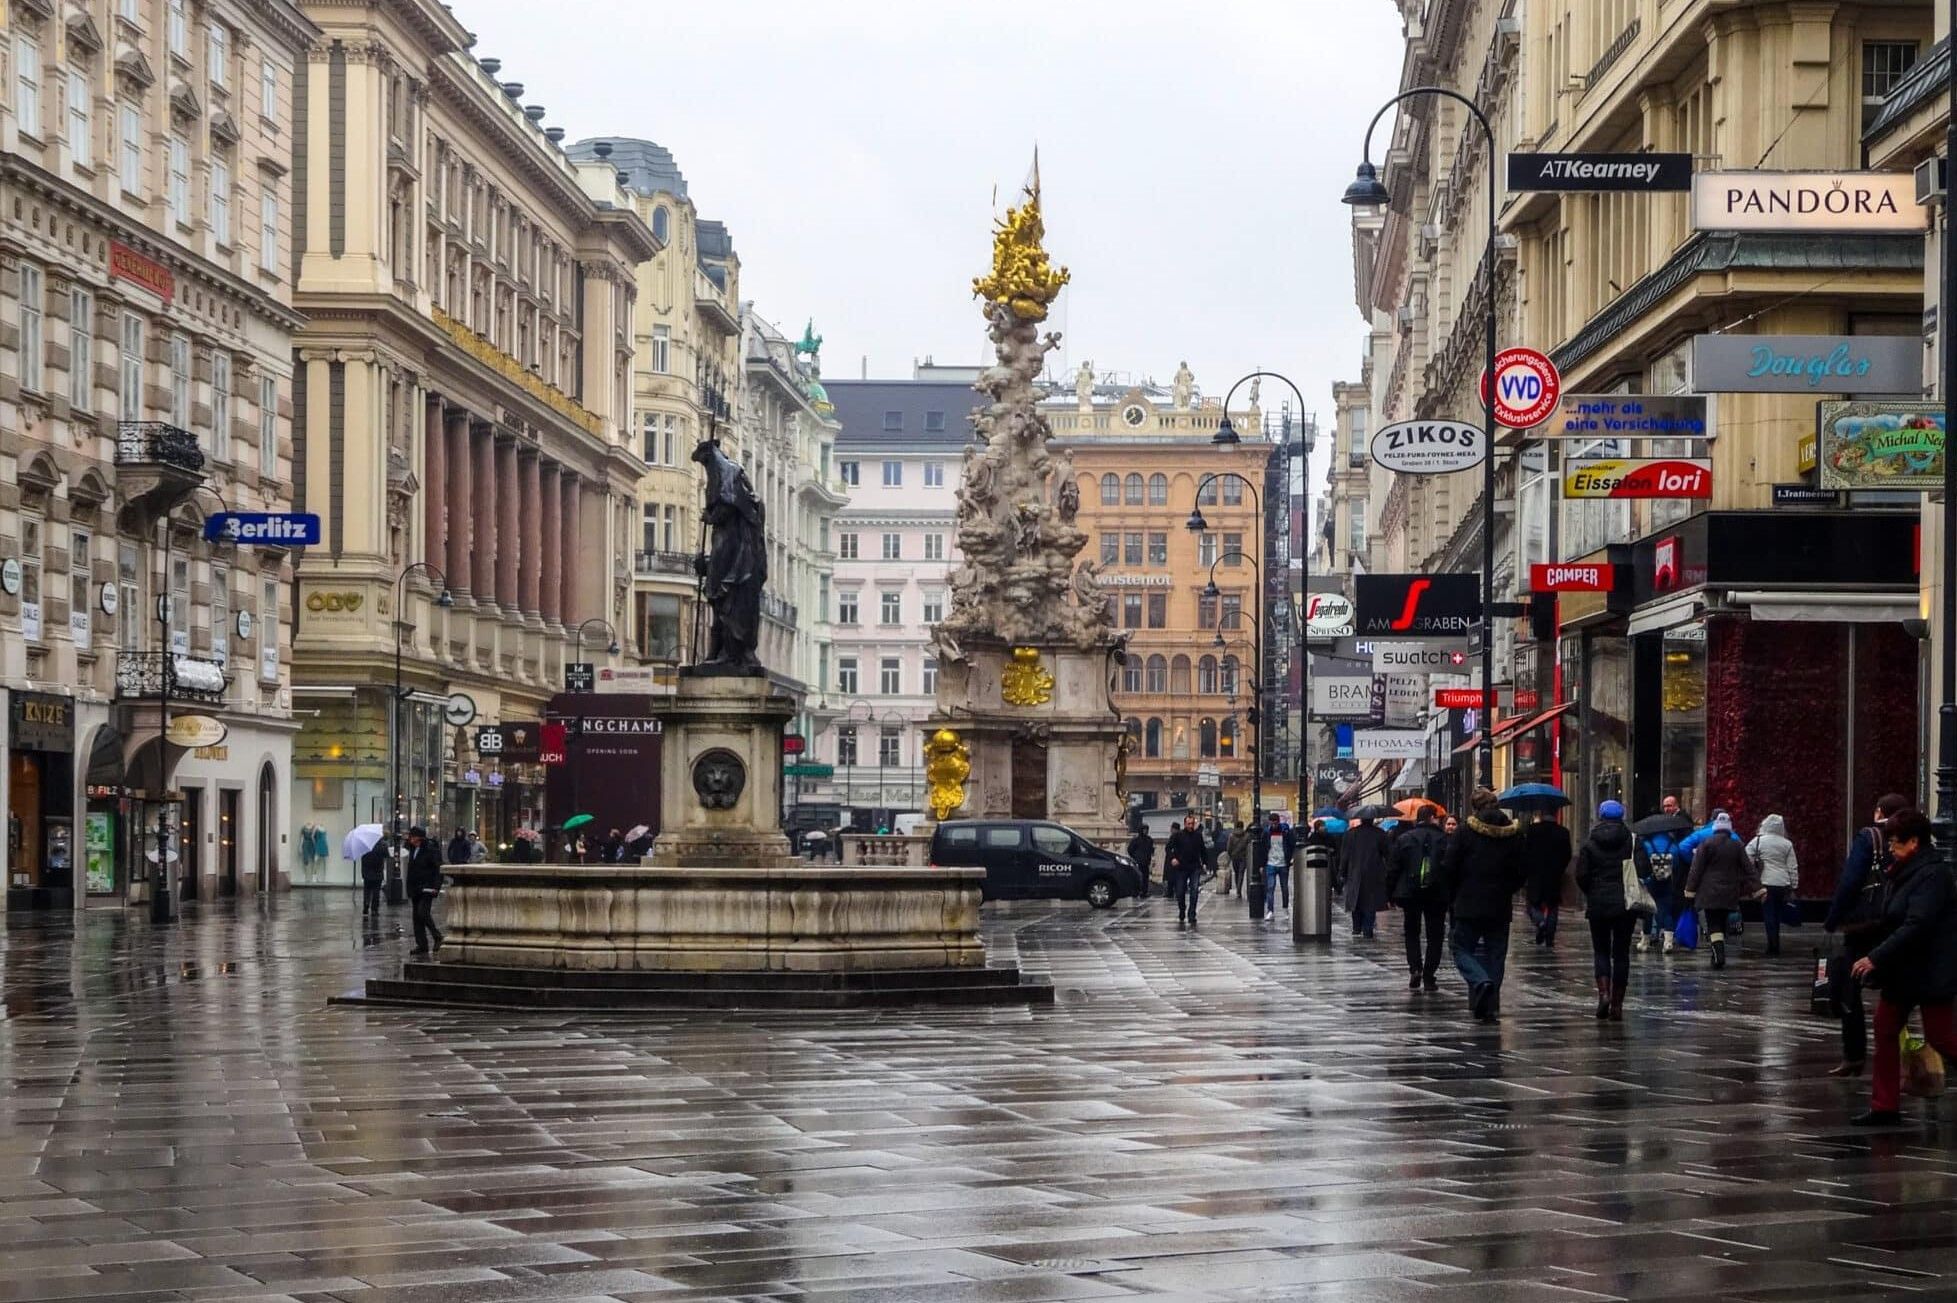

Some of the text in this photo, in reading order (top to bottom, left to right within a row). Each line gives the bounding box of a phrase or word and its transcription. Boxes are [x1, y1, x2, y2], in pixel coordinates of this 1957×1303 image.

[1539, 159, 1661, 183] ATKearney
[1726, 188, 1898, 214] PANDORA
[1747, 342, 1871, 386] Douglas
[1501, 375, 1541, 400] VVD
[1622, 401, 1643, 415] als
[1565, 416, 1704, 433] eine Versicherung
[1386, 425, 1476, 450] ZIKOS
[1877, 430, 1921, 449] Michal
[1573, 474, 1652, 491] Eissalon
[225, 517, 307, 538] Berlitz
[1547, 568, 1598, 587] CAMPER
[1310, 625, 1350, 636] SPRESSO
[1366, 616, 1470, 630] AM GRABEN
[1382, 650, 1450, 665] swatch
[1442, 693, 1483, 705] Triumph
[25, 702, 65, 723] KNIZE
[1359, 738, 1423, 748] THOMAS
[1039, 864, 1072, 872] RICOH
